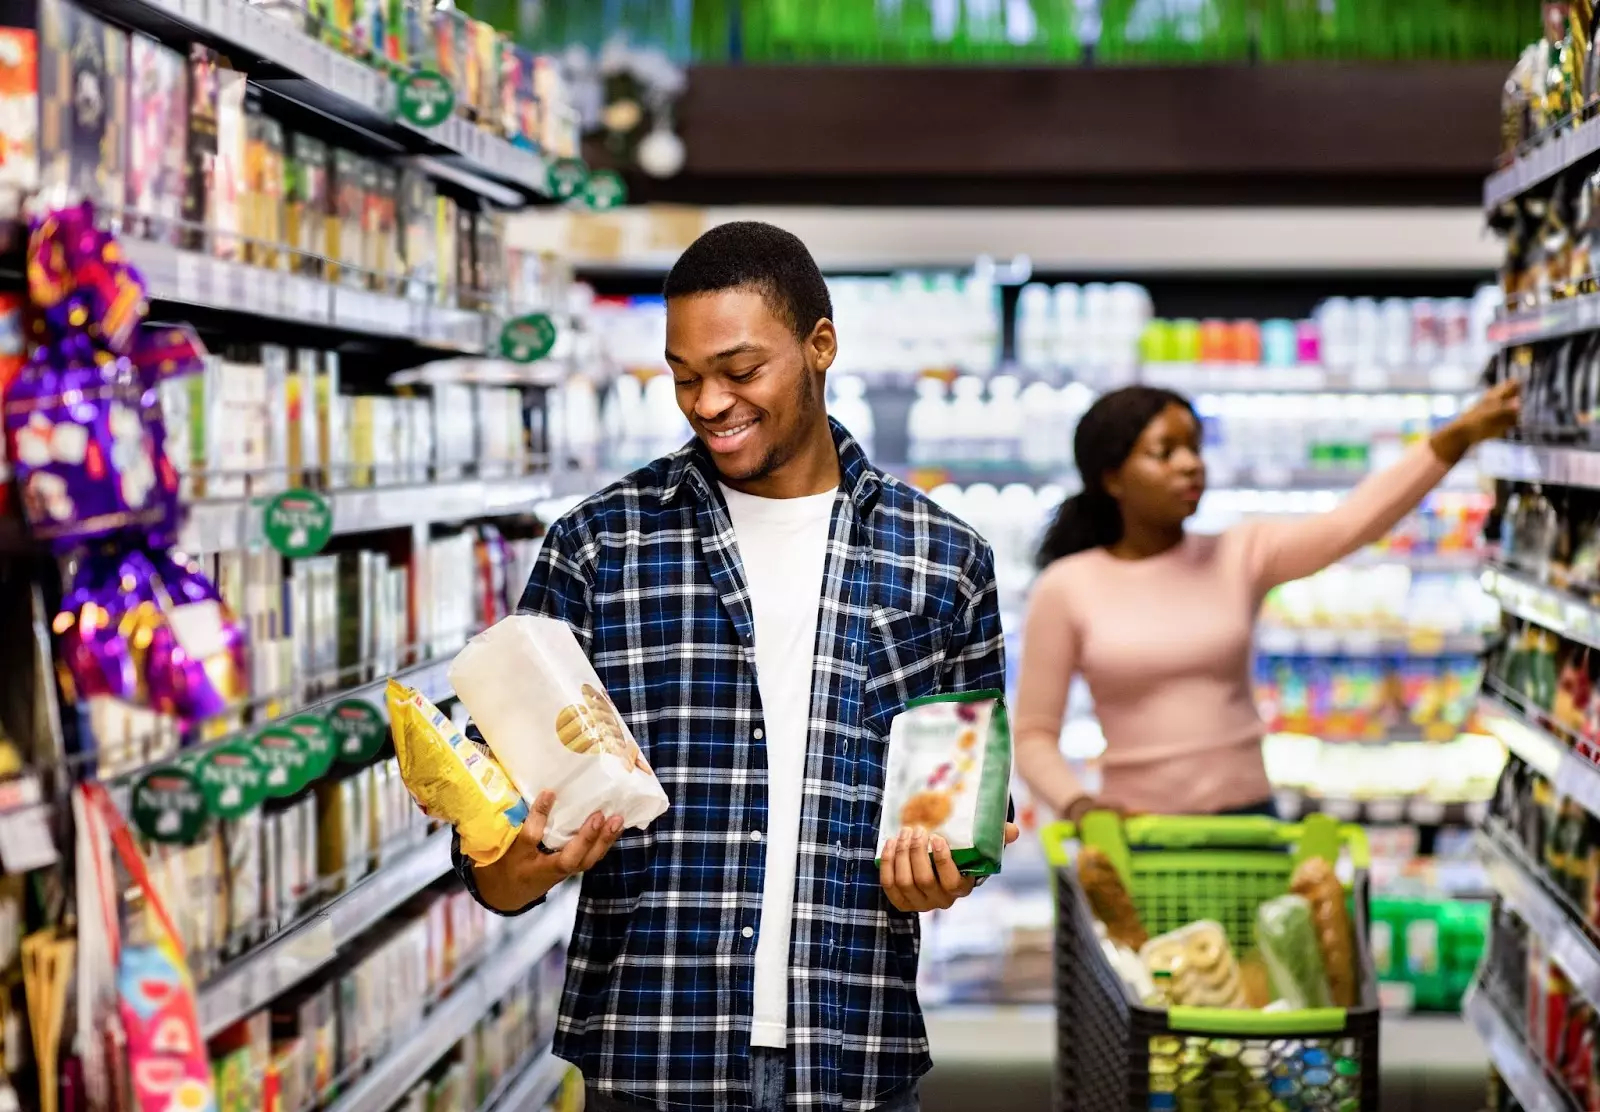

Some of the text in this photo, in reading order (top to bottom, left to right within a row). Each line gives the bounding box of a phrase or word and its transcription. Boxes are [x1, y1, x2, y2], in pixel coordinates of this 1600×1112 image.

[271, 510, 324, 530] NEW
[331, 718, 377, 736] NEW
[253, 746, 306, 767] NEW
[203, 764, 260, 786] NEW
[138, 788, 201, 812] NEW
